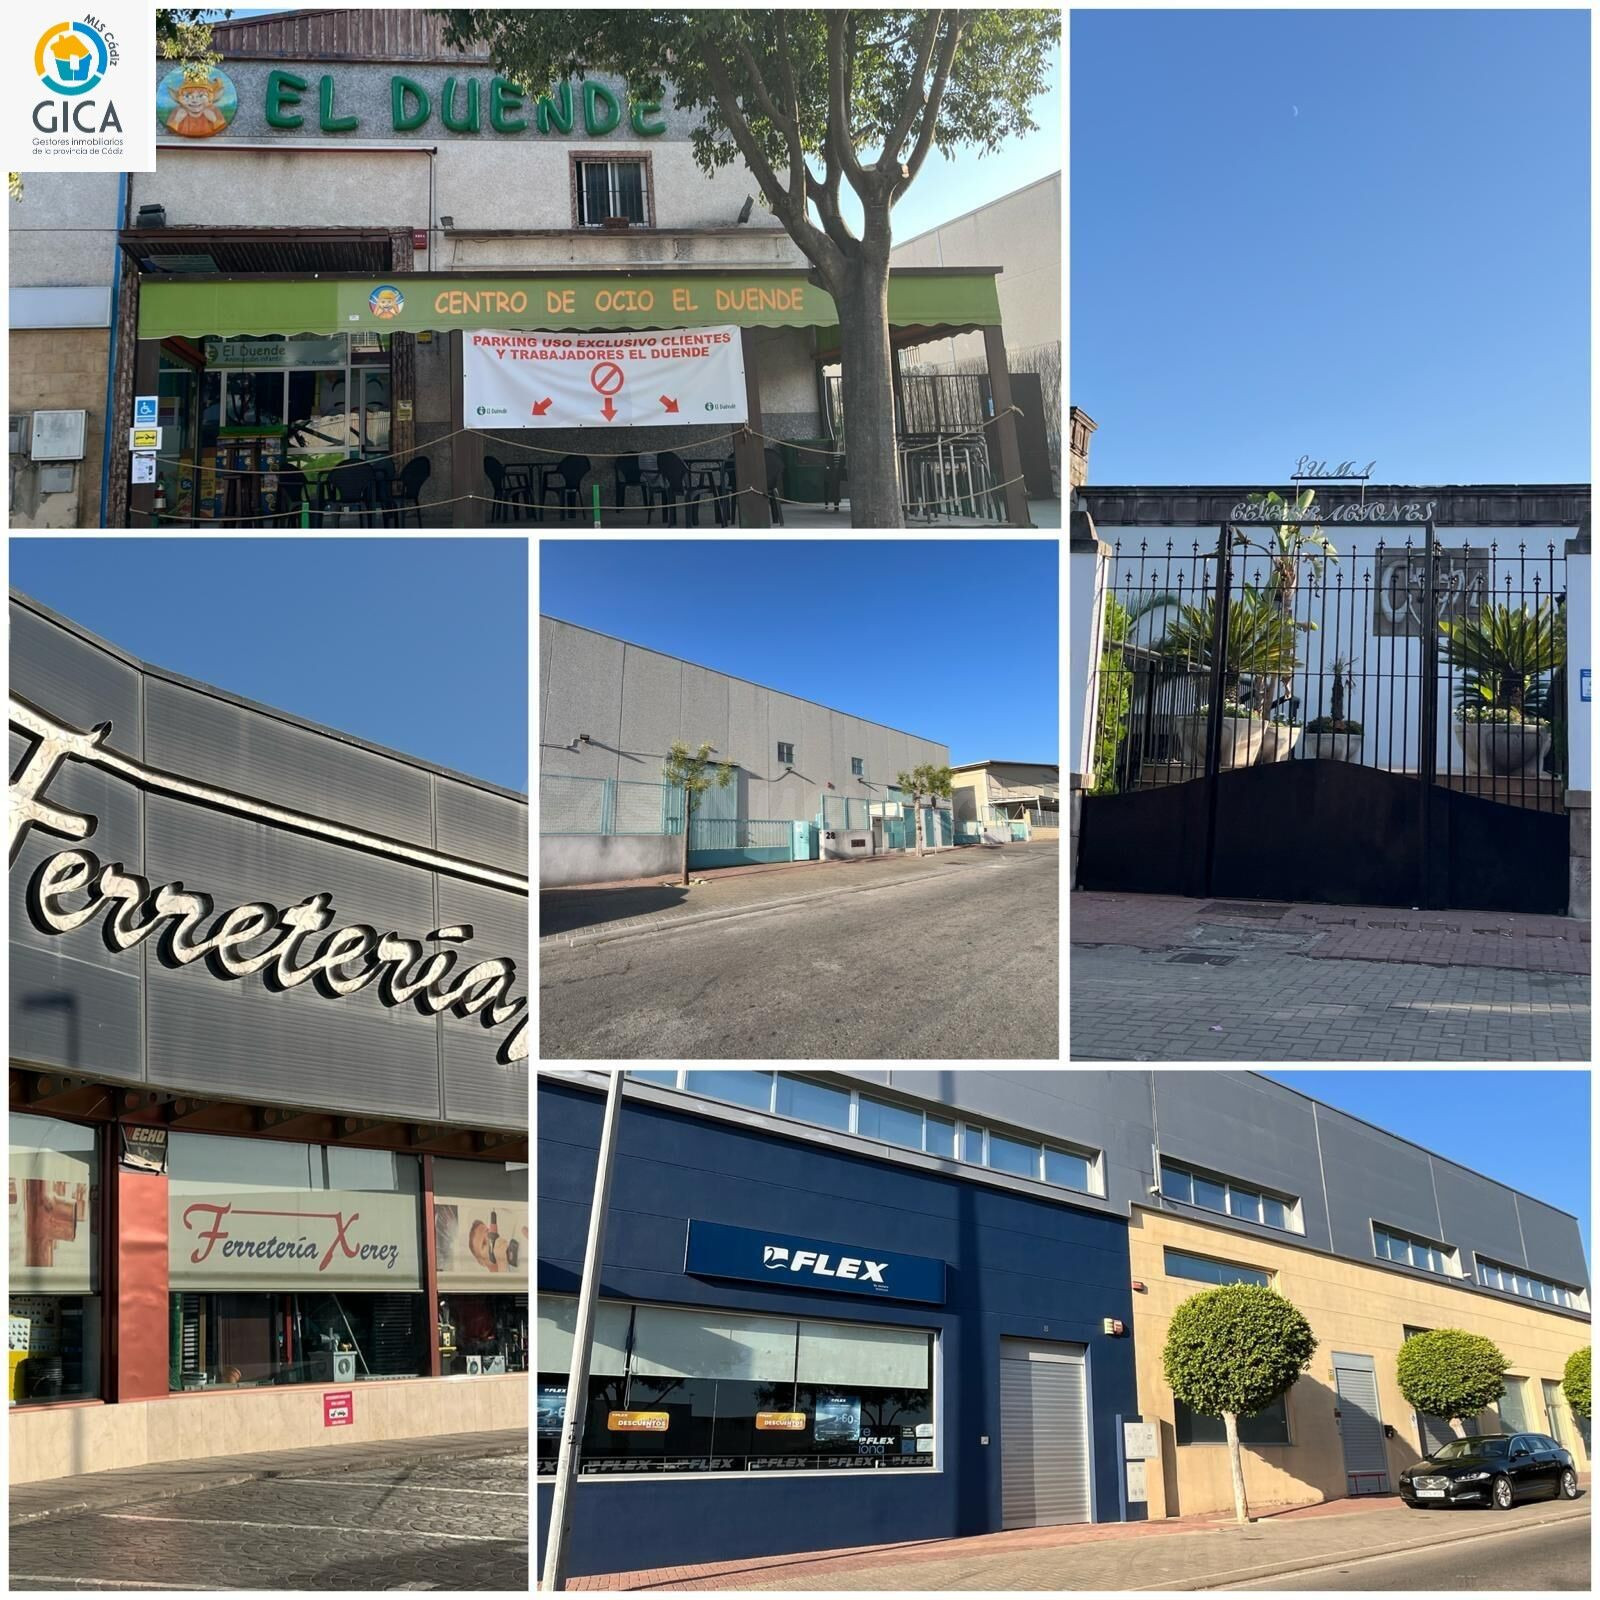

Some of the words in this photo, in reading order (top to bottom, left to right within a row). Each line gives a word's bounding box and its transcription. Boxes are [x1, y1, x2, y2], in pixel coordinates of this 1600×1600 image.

[265, 70, 359, 132] EL
[391, 76, 668, 137] DUENDE
[435, 290, 528, 314] CENTRO
[547, 290, 576, 313] DE
[595, 289, 655, 312] OCIO
[672, 288, 698, 311] EL
[715, 287, 804, 312] DUENDE
[472, 335, 538, 348] PARKING
[542, 338, 572, 348] USO
[576, 337, 657, 348] EXCLUSIVO
[662, 333, 731, 346] CLIENTES
[223, 344, 235, 357] El
[240, 343, 286, 357] Duende
[496, 349, 505, 360] Y
[509, 348, 625, 361] TRABAJADORES
[629, 348, 646, 360] EL
[651, 346, 710, 359] DUENDE
[1292, 455, 1376, 477] LUMA
[132, 1128, 166, 1143] ECHO
[183, 1202, 319, 1264] Ferretería
[319, 1211, 399, 1272] Xerez
[790, 1250, 889, 1283] FLEX
[764, 1419, 804, 1427] DESCUENTOS
[866, 1437, 896, 1445] FLEX
[601, 1460, 652, 1471] FLEX
[689, 1458, 735, 1470] FLEX
[766, 1457, 808, 1468] FLEX
[836, 1456, 874, 1467] FLEX
[901, 1456, 932, 1465] FLEX
